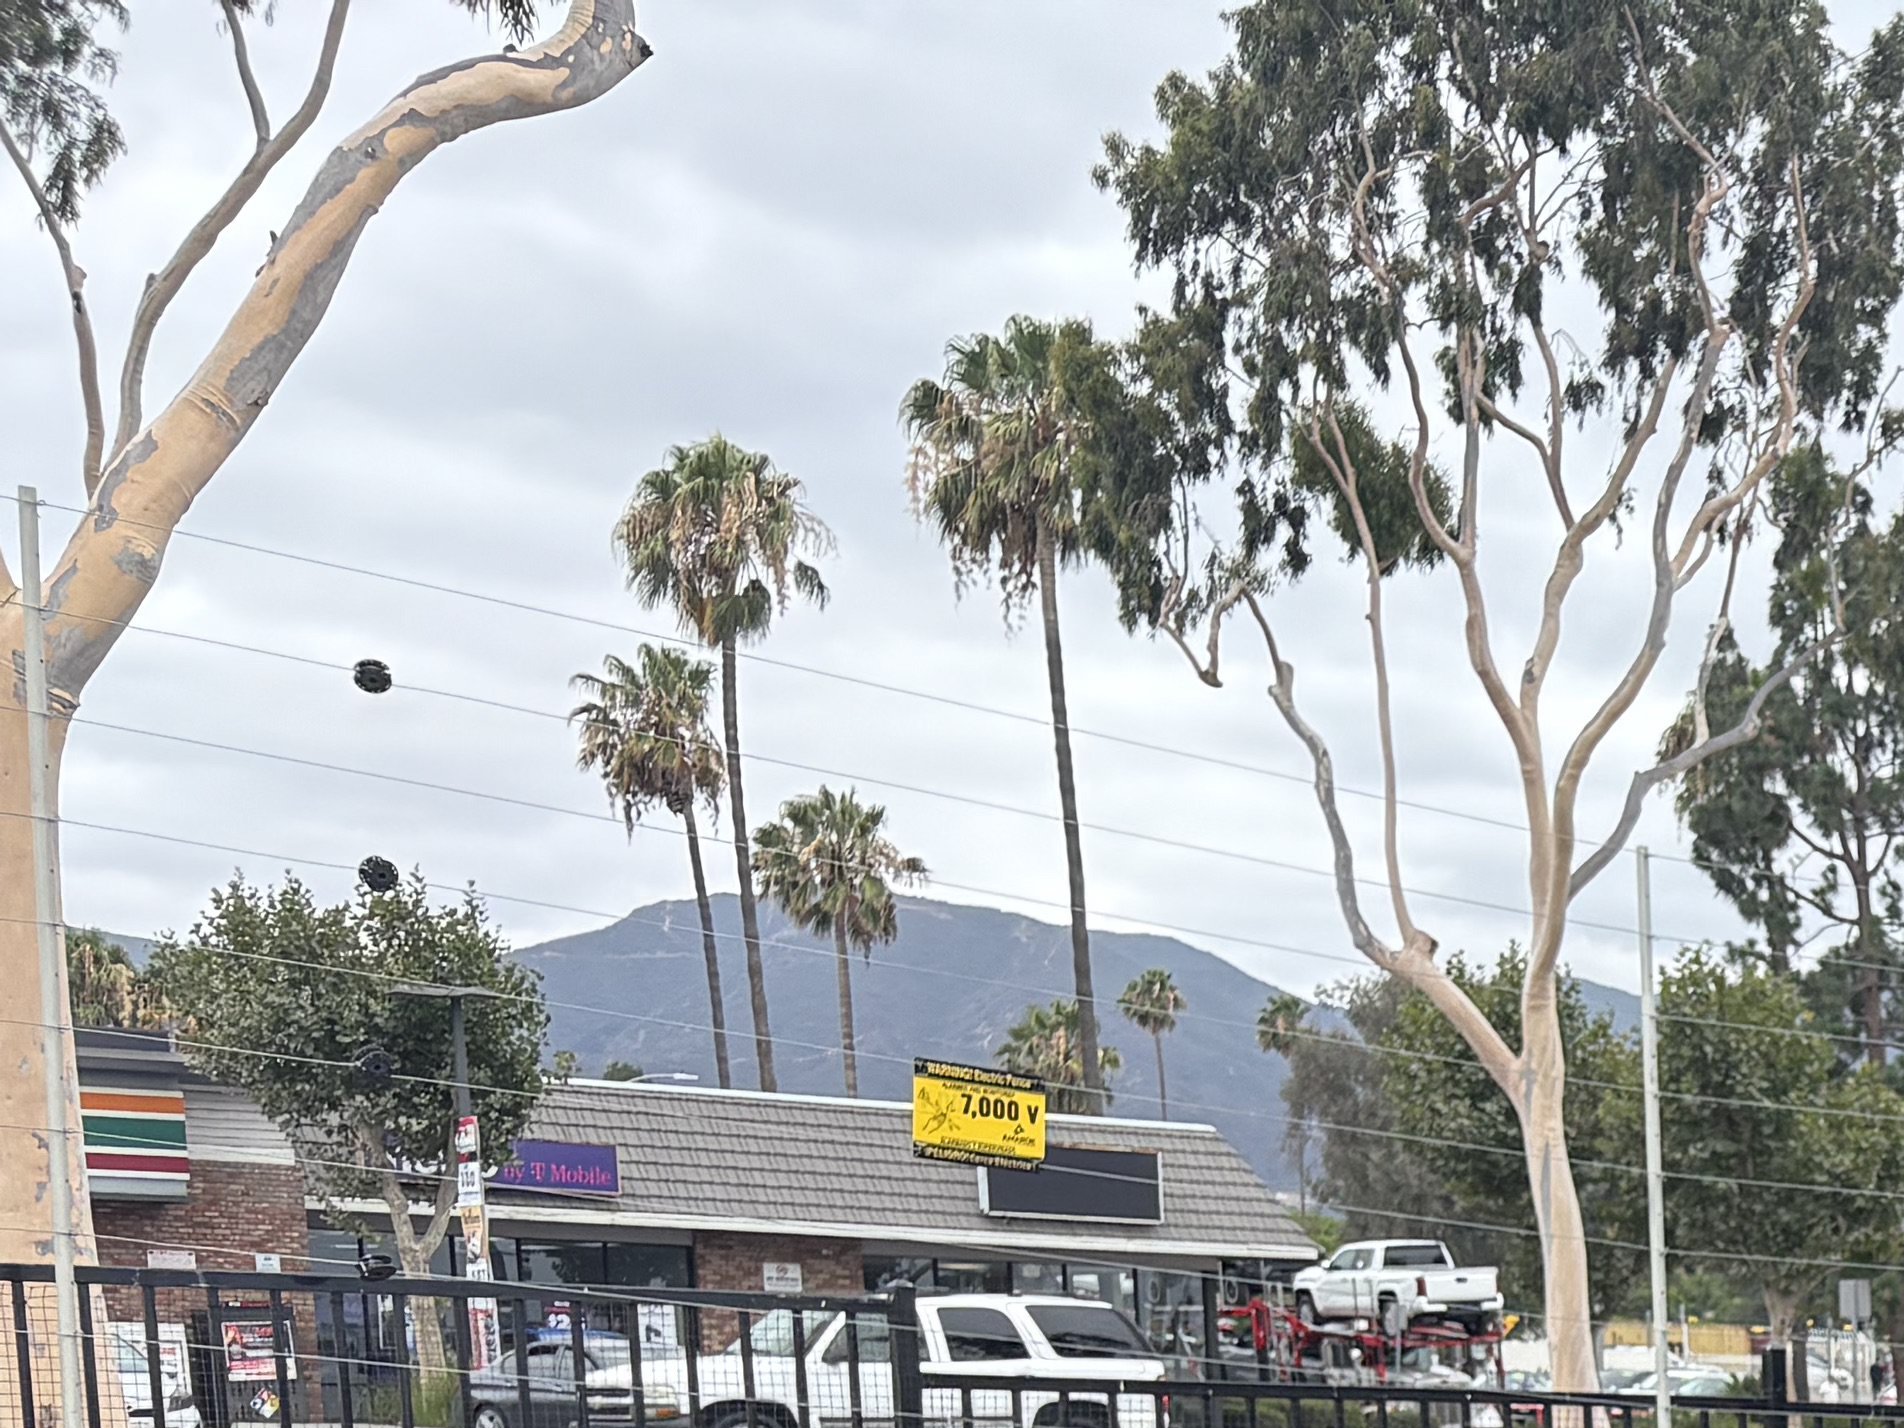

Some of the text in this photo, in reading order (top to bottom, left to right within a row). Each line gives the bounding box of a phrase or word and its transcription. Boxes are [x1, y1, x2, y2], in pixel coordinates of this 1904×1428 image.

[961, 1093, 1039, 1125] 7,000 V
[550, 1163, 612, 1185] Mobile
